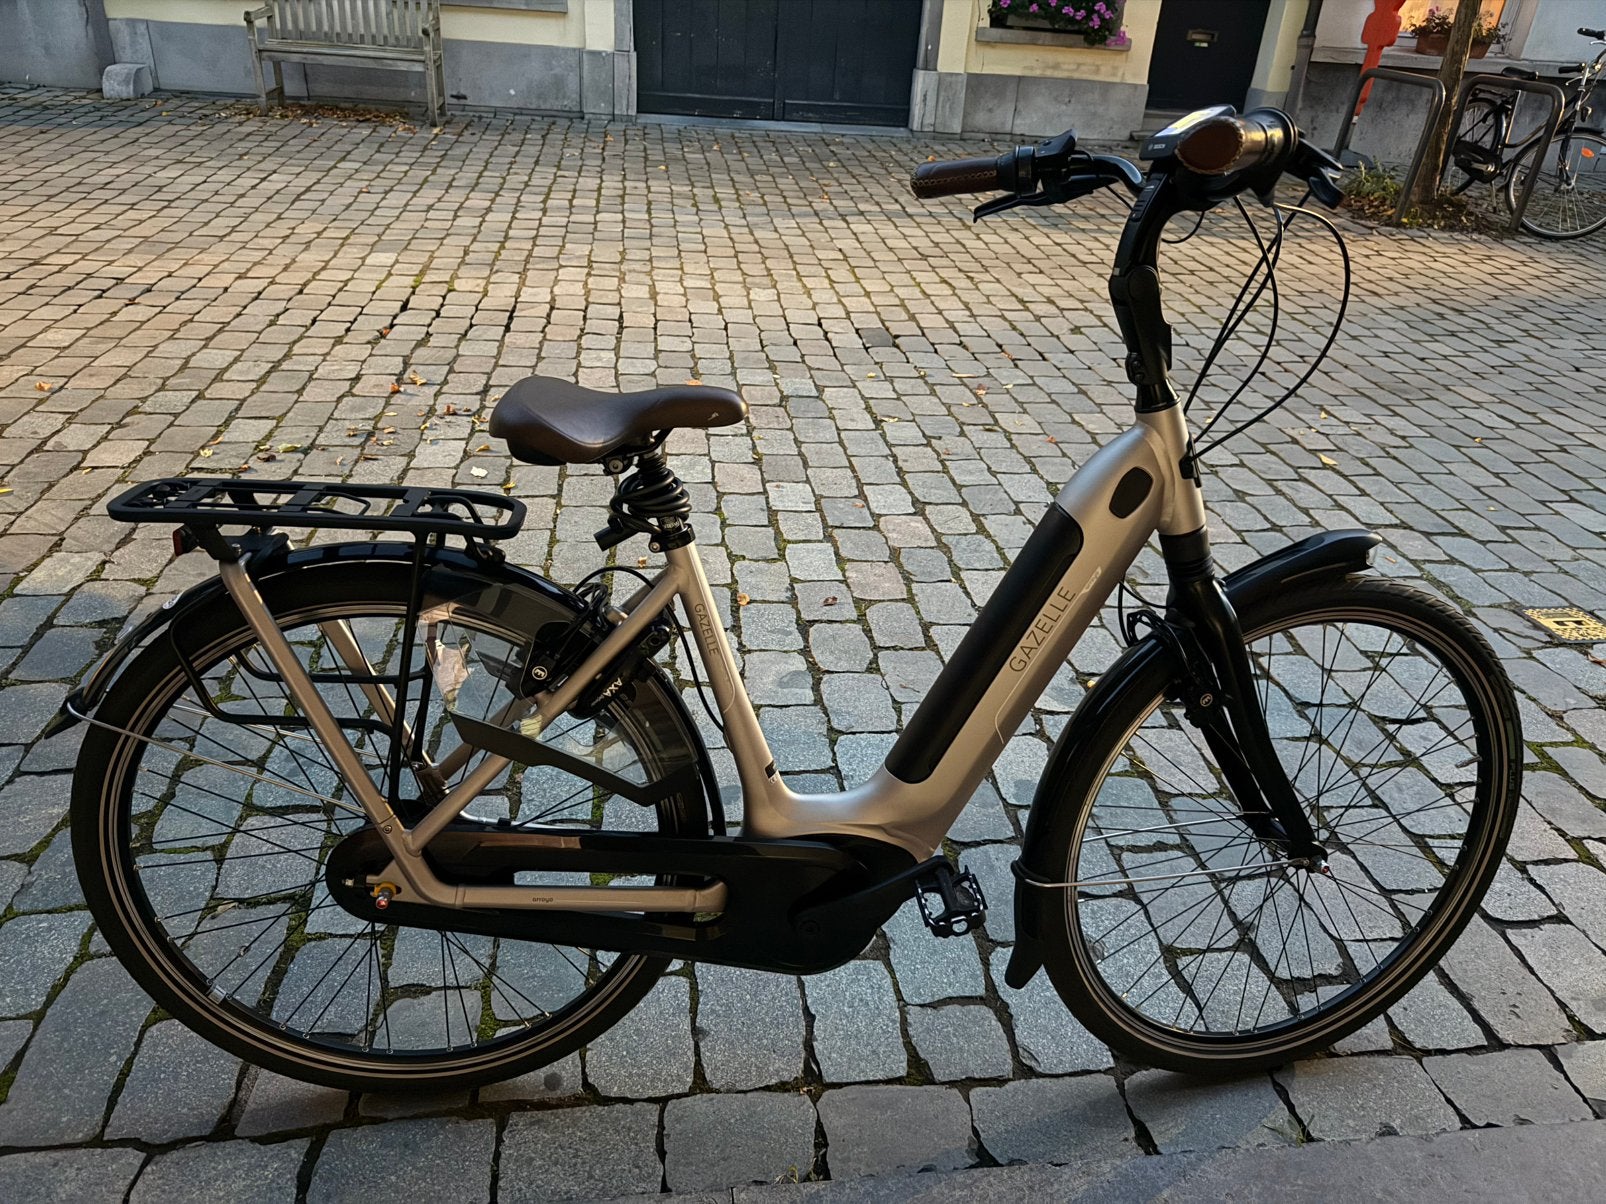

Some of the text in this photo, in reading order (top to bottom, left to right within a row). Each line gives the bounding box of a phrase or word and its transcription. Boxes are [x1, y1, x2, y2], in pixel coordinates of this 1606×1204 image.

[694, 603, 720, 656] GAZELLE
[1009, 586, 1076, 672] GAZELLE
[602, 677, 623, 697] AXA
